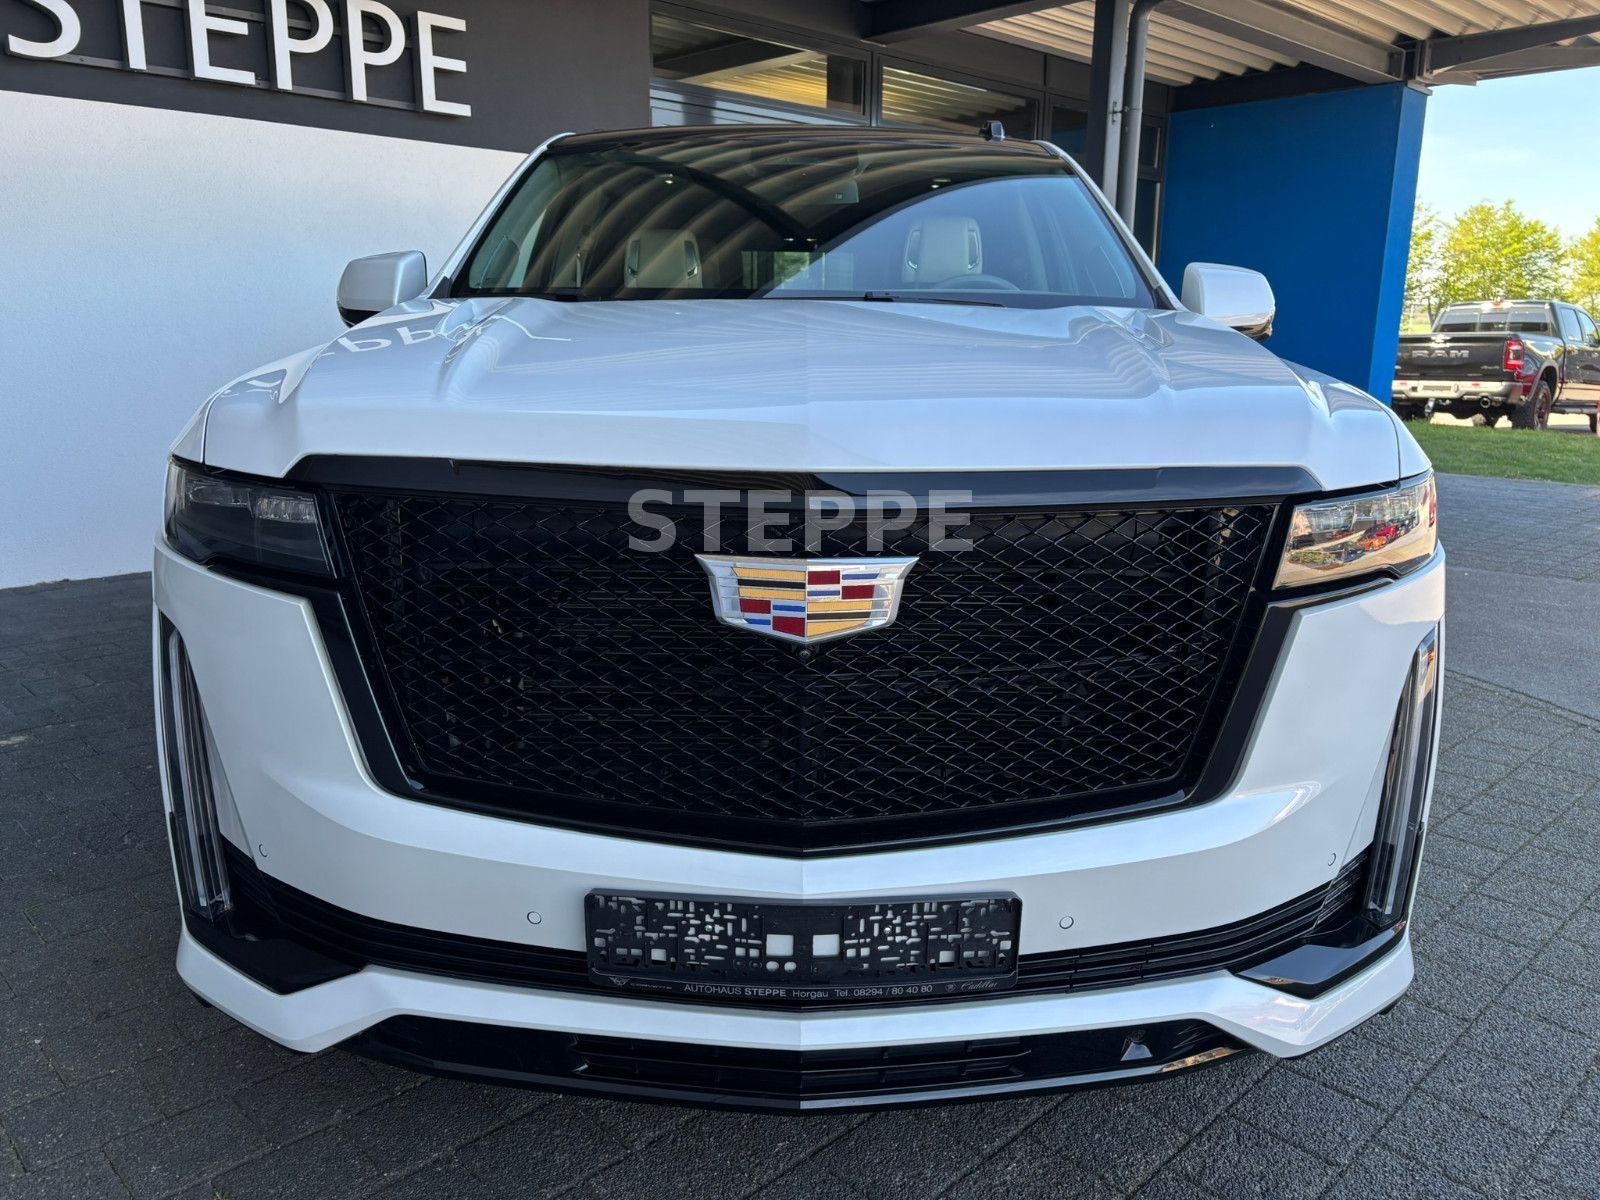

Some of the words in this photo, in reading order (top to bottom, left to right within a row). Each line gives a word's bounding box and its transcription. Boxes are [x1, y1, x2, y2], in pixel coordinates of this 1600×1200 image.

[1412, 350, 1470, 358] RAM
[683, 984, 742, 995] AUTOHAUS
[744, 987, 787, 997] STEPPE
[792, 989, 829, 999] Horgau
[835, 989, 850, 997] Tel.
[853, 987, 883, 997] 08294
[891, 986, 904, 995] 80
[906, 985, 919, 994] 40
[920, 984, 933, 993] 80
